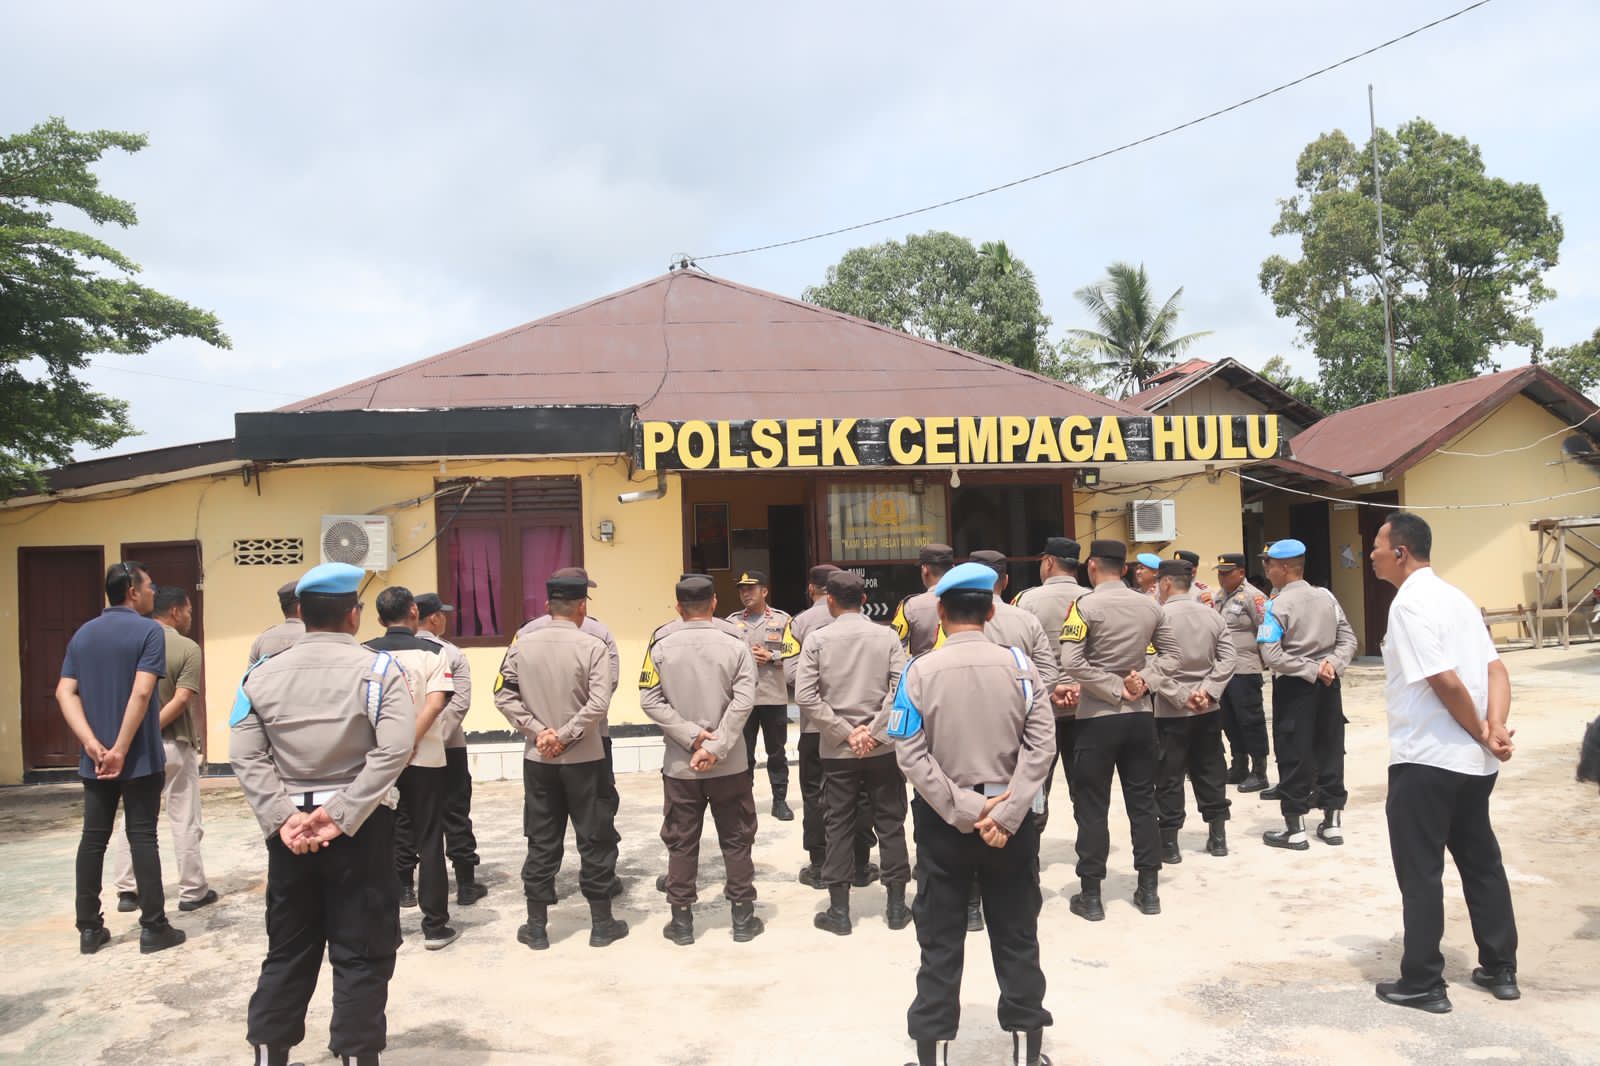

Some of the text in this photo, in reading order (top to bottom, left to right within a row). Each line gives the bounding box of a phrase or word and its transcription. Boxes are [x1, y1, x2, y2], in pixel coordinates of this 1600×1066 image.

[643, 414, 1279, 470] POLSEK CEMPAGA HULU
